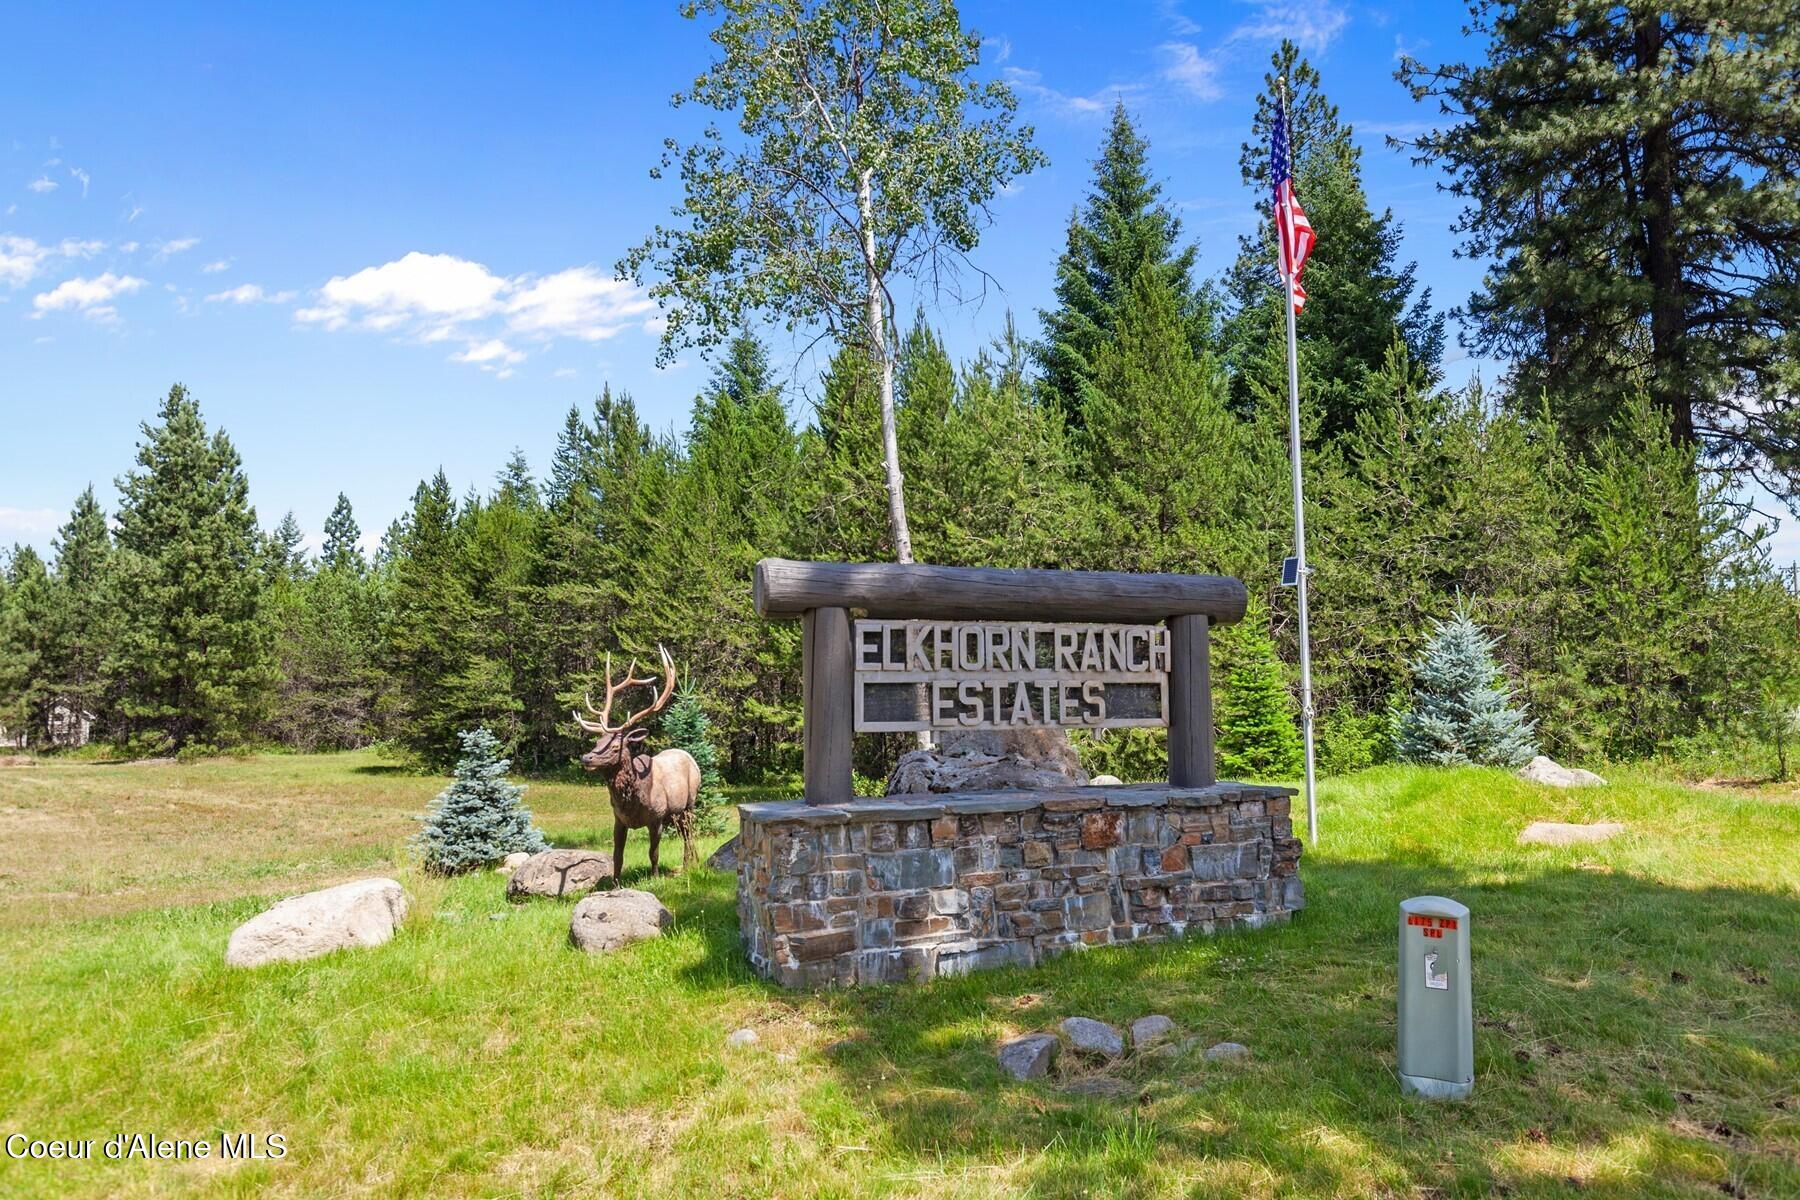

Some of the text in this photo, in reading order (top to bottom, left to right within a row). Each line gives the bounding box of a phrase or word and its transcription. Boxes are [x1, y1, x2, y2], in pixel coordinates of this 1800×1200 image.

[855, 623, 1172, 673] ELKHORN RANCH
[932, 679, 1107, 727] ESTATES
